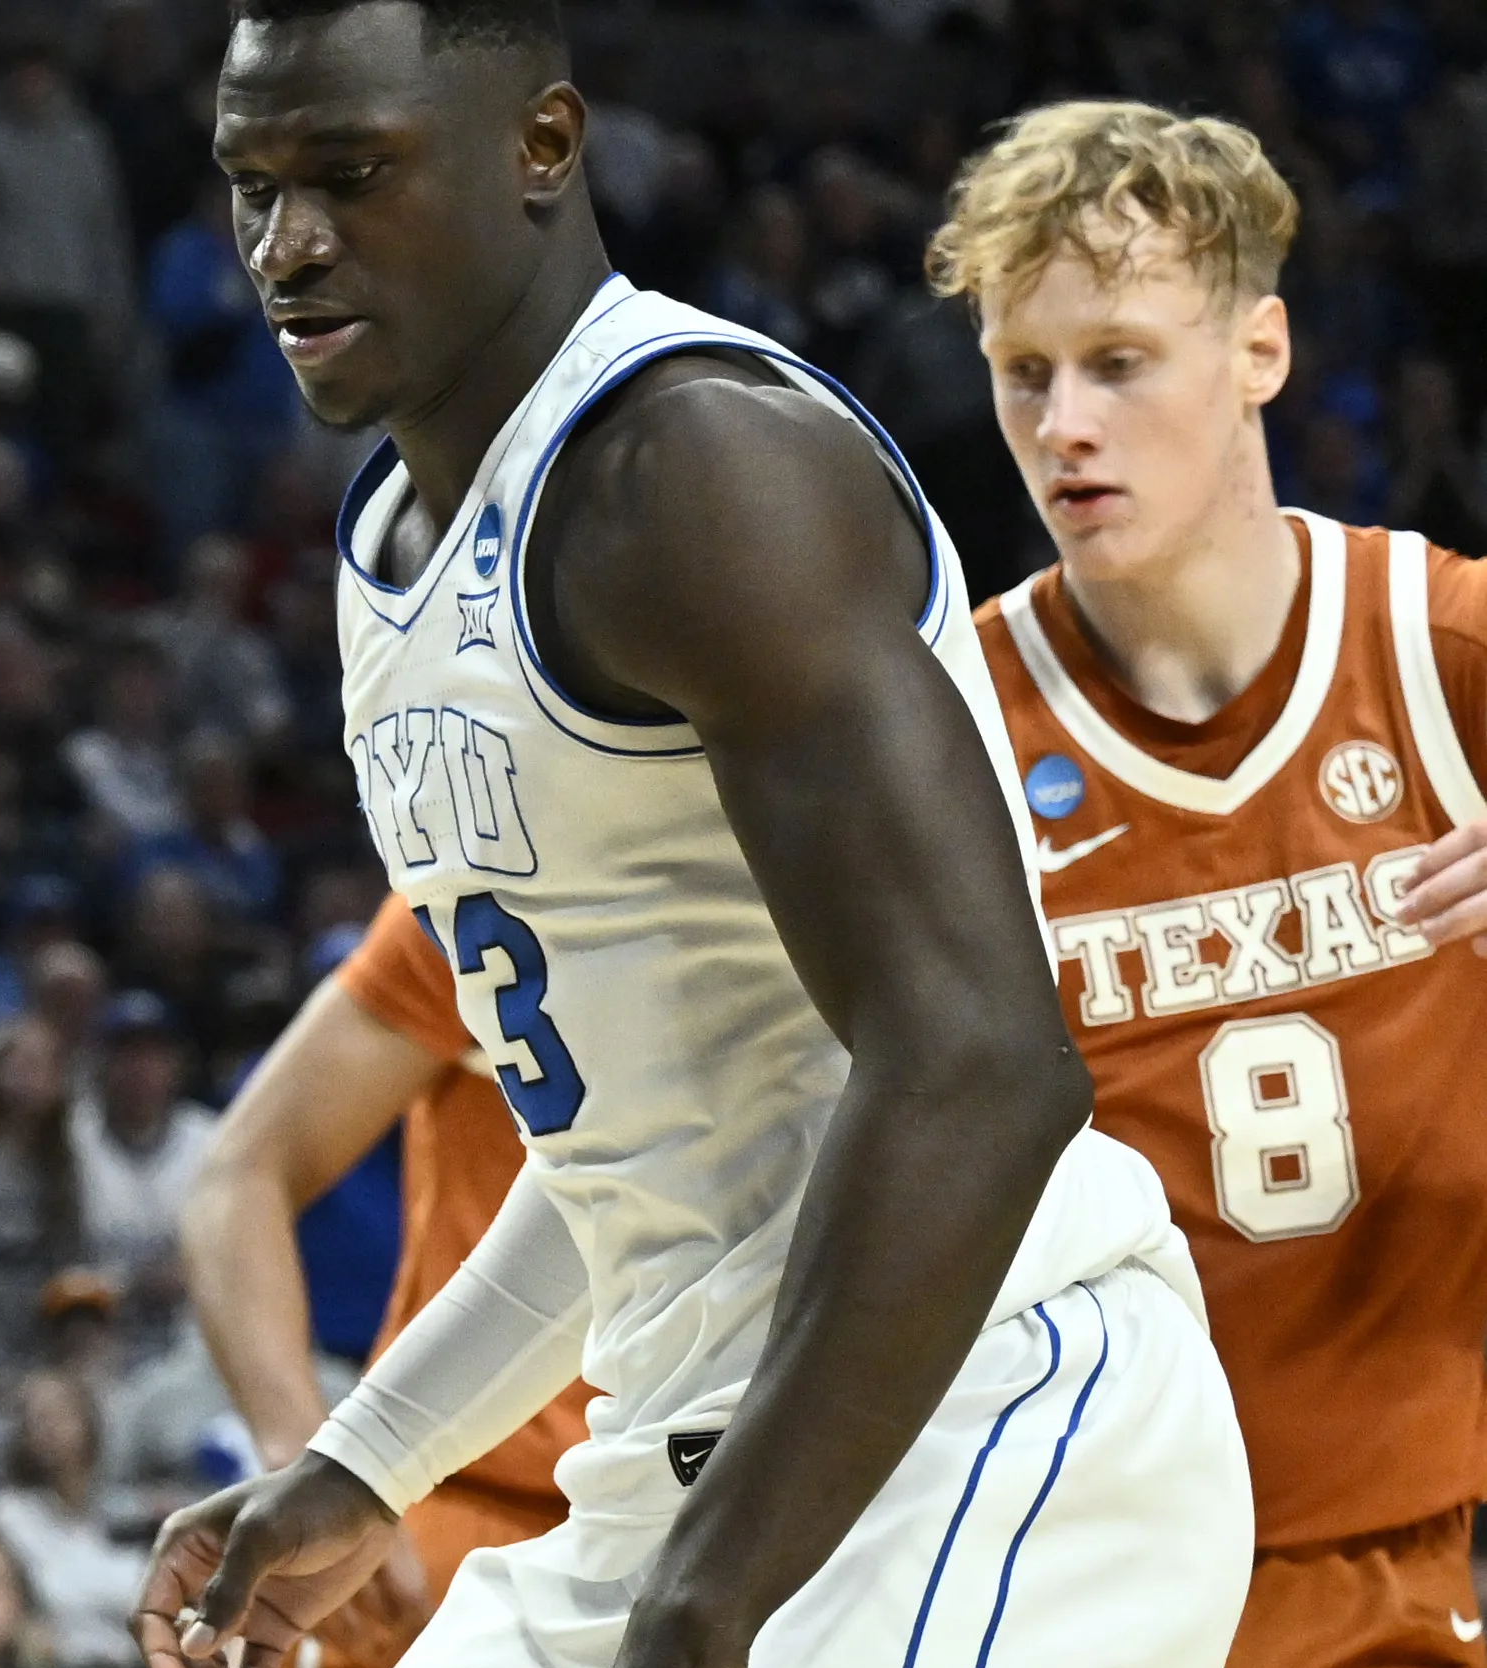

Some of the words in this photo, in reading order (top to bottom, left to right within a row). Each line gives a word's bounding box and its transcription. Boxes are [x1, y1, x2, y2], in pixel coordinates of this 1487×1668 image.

[1325, 748, 1397, 814] SEC
[1048, 843, 1435, 1027] TEXAS
[1198, 1012, 1361, 1243] 8
